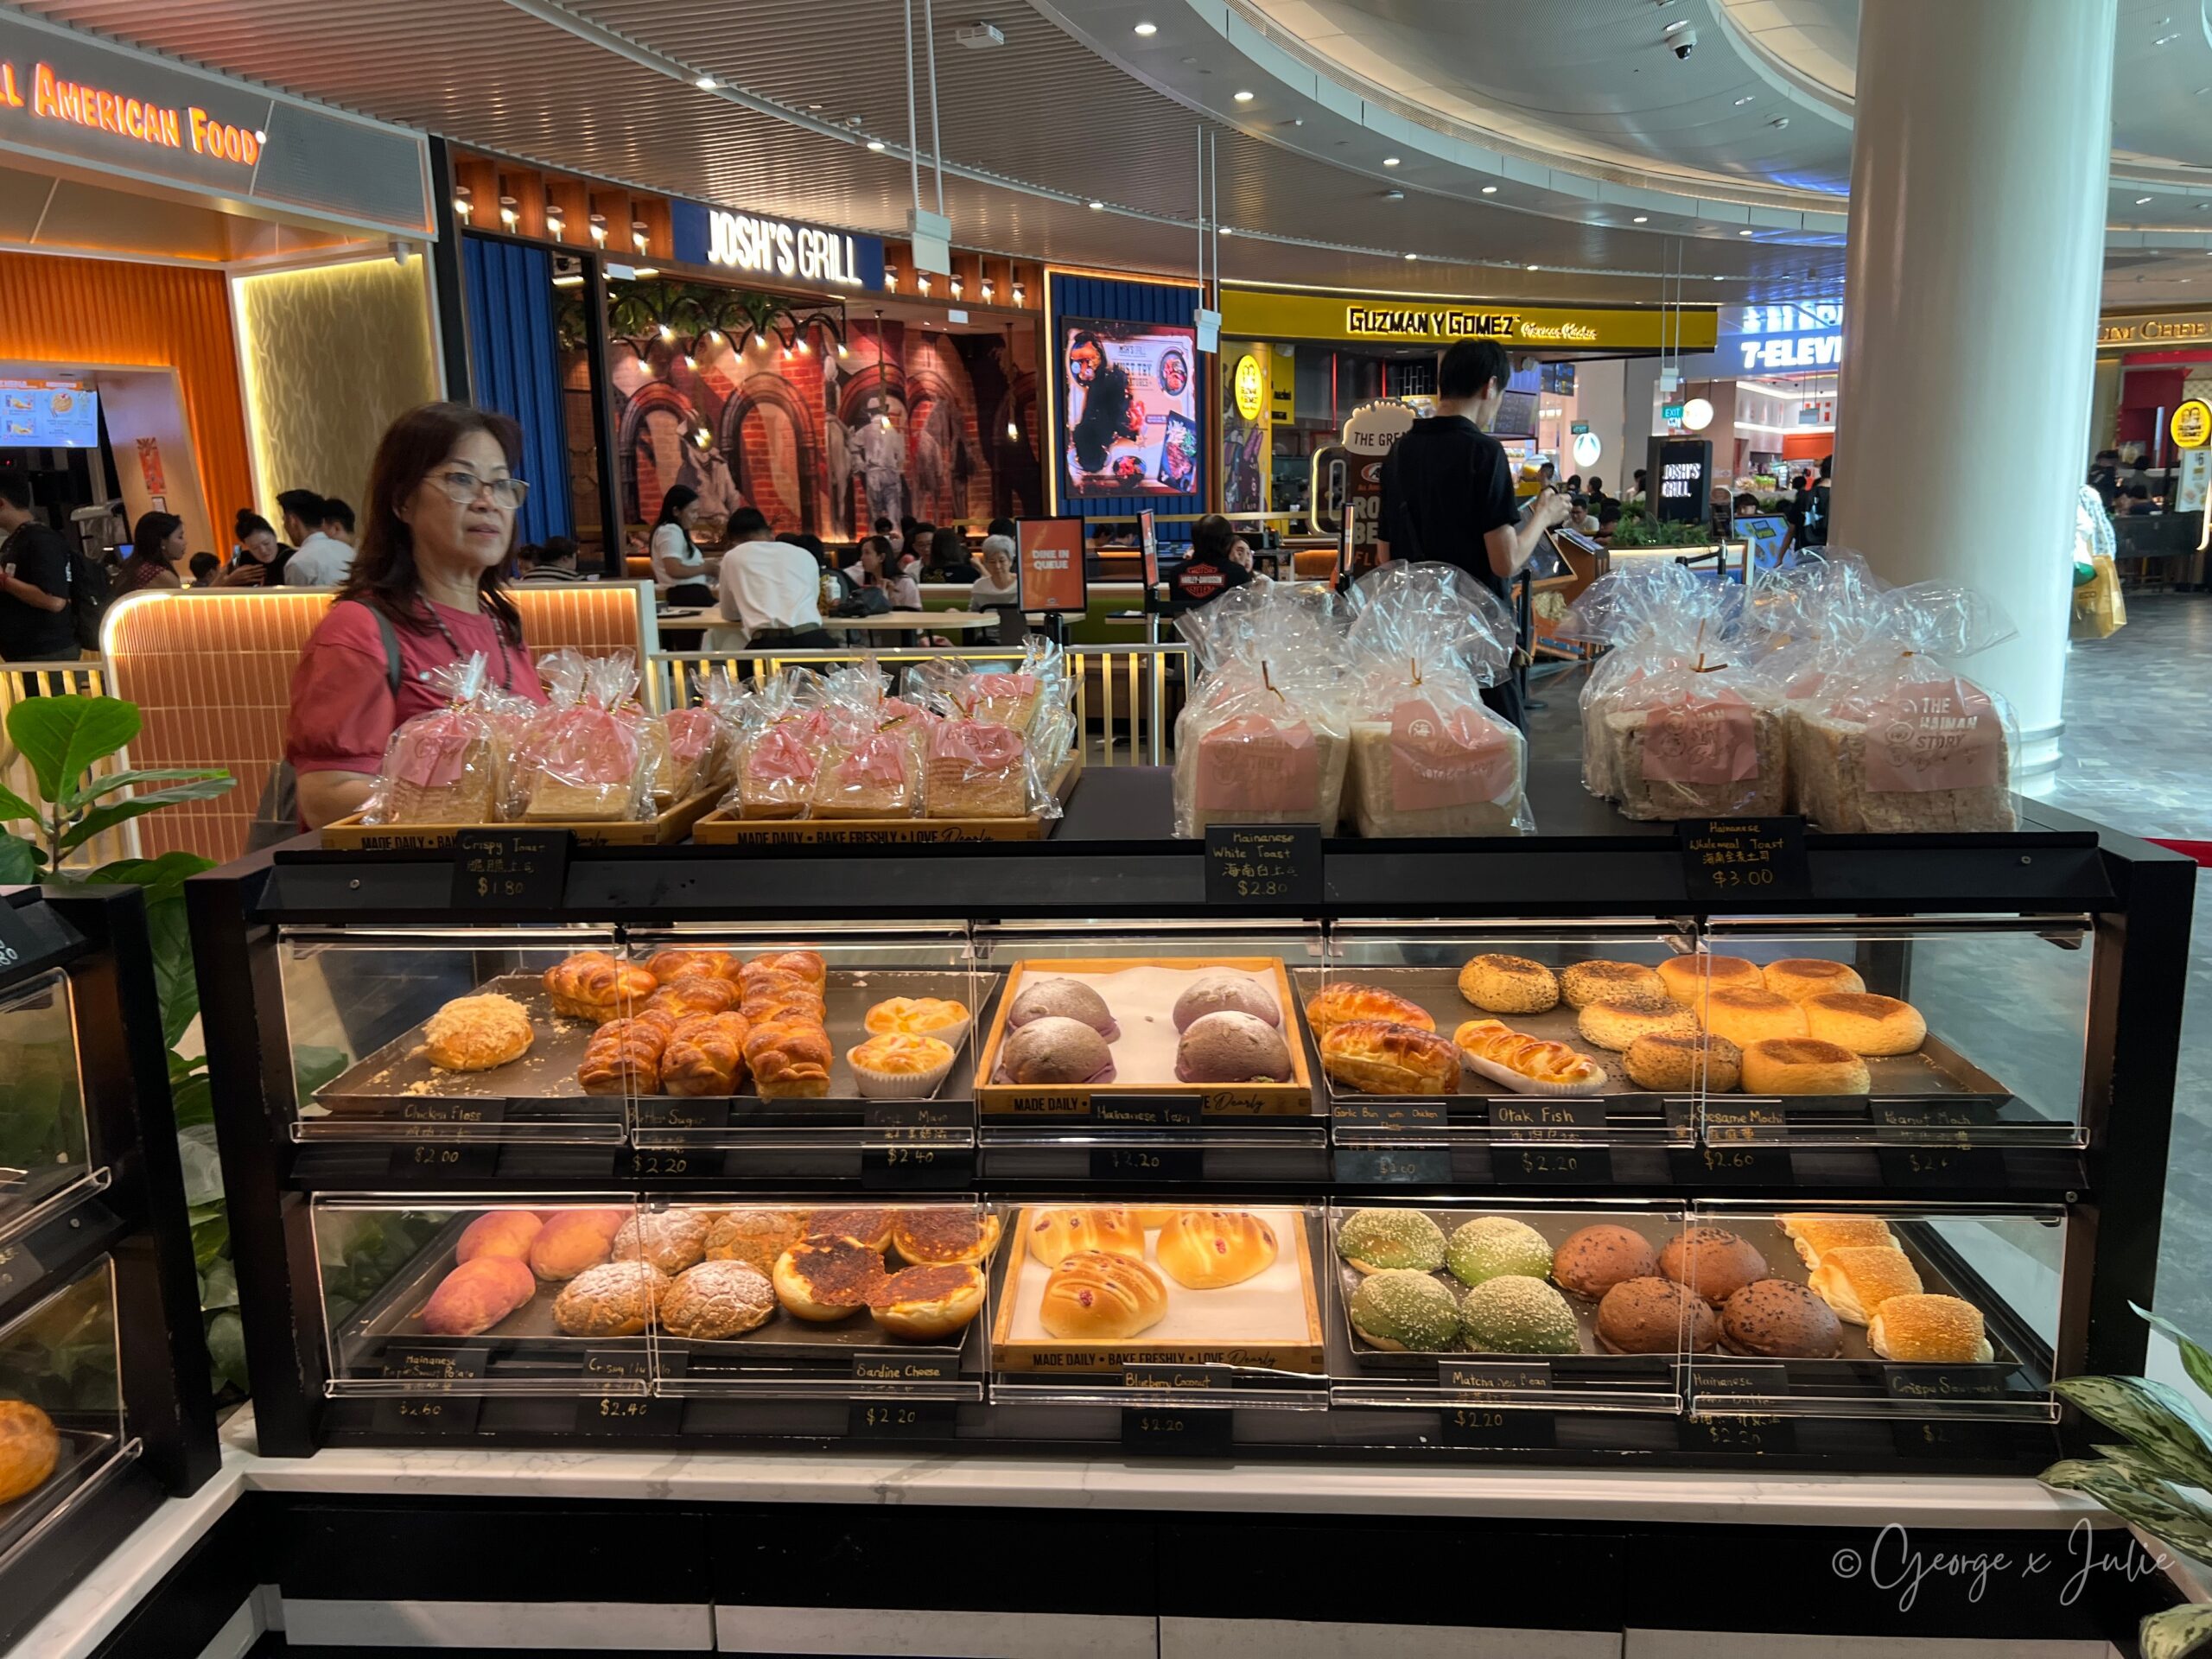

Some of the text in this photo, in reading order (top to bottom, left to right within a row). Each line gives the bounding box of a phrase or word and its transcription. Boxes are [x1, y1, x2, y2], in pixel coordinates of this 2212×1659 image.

[35, 63, 181, 148] AMERICAN
[188, 106, 259, 165] FOOD
[708, 210, 863, 284] JOSH'S GRILL
[1347, 306, 1427, 336] GUZMAN
[1433, 312, 1446, 336] Y
[1447, 310, 1516, 338] GOMEZ
[2141, 321, 2206, 340] CHEE
[1665, 408, 1681, 417] EXIT
[1354, 432, 1374, 447] THE
[1033, 550, 1070, 559] DINE IN
[1033, 560, 1069, 571] QUEUE
[1922, 696, 1951, 713] THE
[1916, 734, 1966, 749] STORY
[395, 836, 424, 849] DAILY
[737, 831, 769, 843] MADE
[772, 831, 804, 843] DAILY
[1233, 830, 1295, 843] Hainanese
[1750, 836, 1785, 850] Toast
[462, 835, 504, 855] Crispy
[1212, 844, 1292, 860] White Toast
[1712, 868, 1774, 889] $3.00
[1237, 879, 1288, 897] $2.80
[1014, 1098, 1044, 1112] MADE
[1048, 1097, 1077, 1111] DAILY
[1333, 1106, 1357, 1118] Garlic
[1362, 1106, 1380, 1118] Bun
[451, 1105, 482, 1122] Floss
[1499, 1106, 1575, 1123] Otak Fish
[1750, 1109, 1783, 1124] Mochi
[1522, 1152, 1578, 1173] $2.20
[1703, 1149, 1755, 1171] $2.60
[405, 1354, 457, 1366] Hainanese
[1033, 1353, 1063, 1366] MADE
[1067, 1353, 1096, 1365] DAILY
[1109, 1353, 1136, 1365] BAKE
[856, 1363, 900, 1378] Sardine
[1125, 1372, 1212, 1392] Blueberry Coconut
[1452, 1371, 1495, 1388] Matcha
[600, 1397, 647, 1417] $2.40
